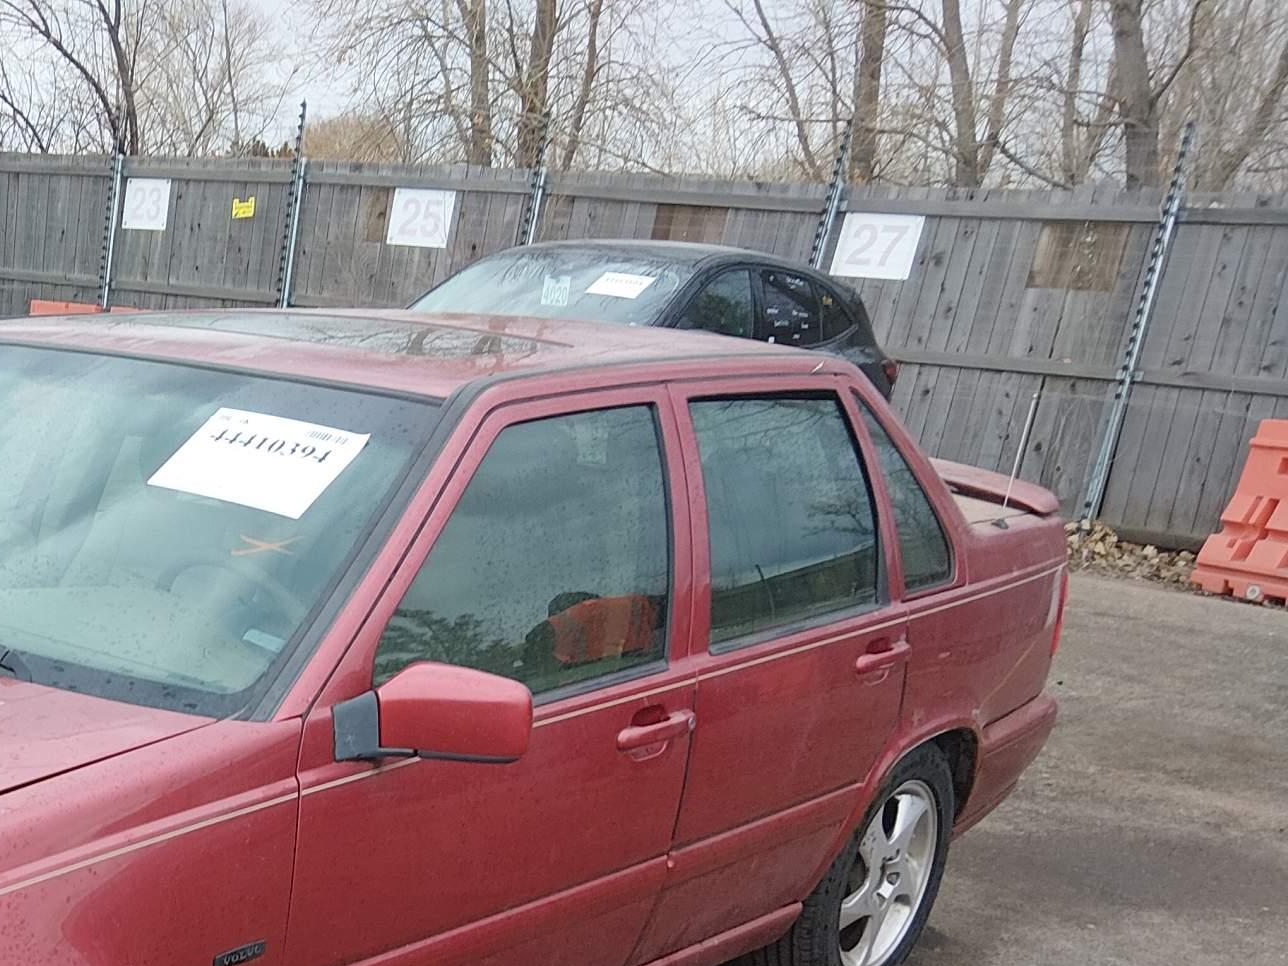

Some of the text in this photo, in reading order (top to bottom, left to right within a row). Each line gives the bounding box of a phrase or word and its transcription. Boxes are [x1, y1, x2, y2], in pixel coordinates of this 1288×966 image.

[131, 187, 162, 220] 23
[398, 198, 442, 237] 25
[845, 224, 911, 267] 27
[211, 428, 334, 464] 44410394
[223, 944, 262, 966] VOLVO
